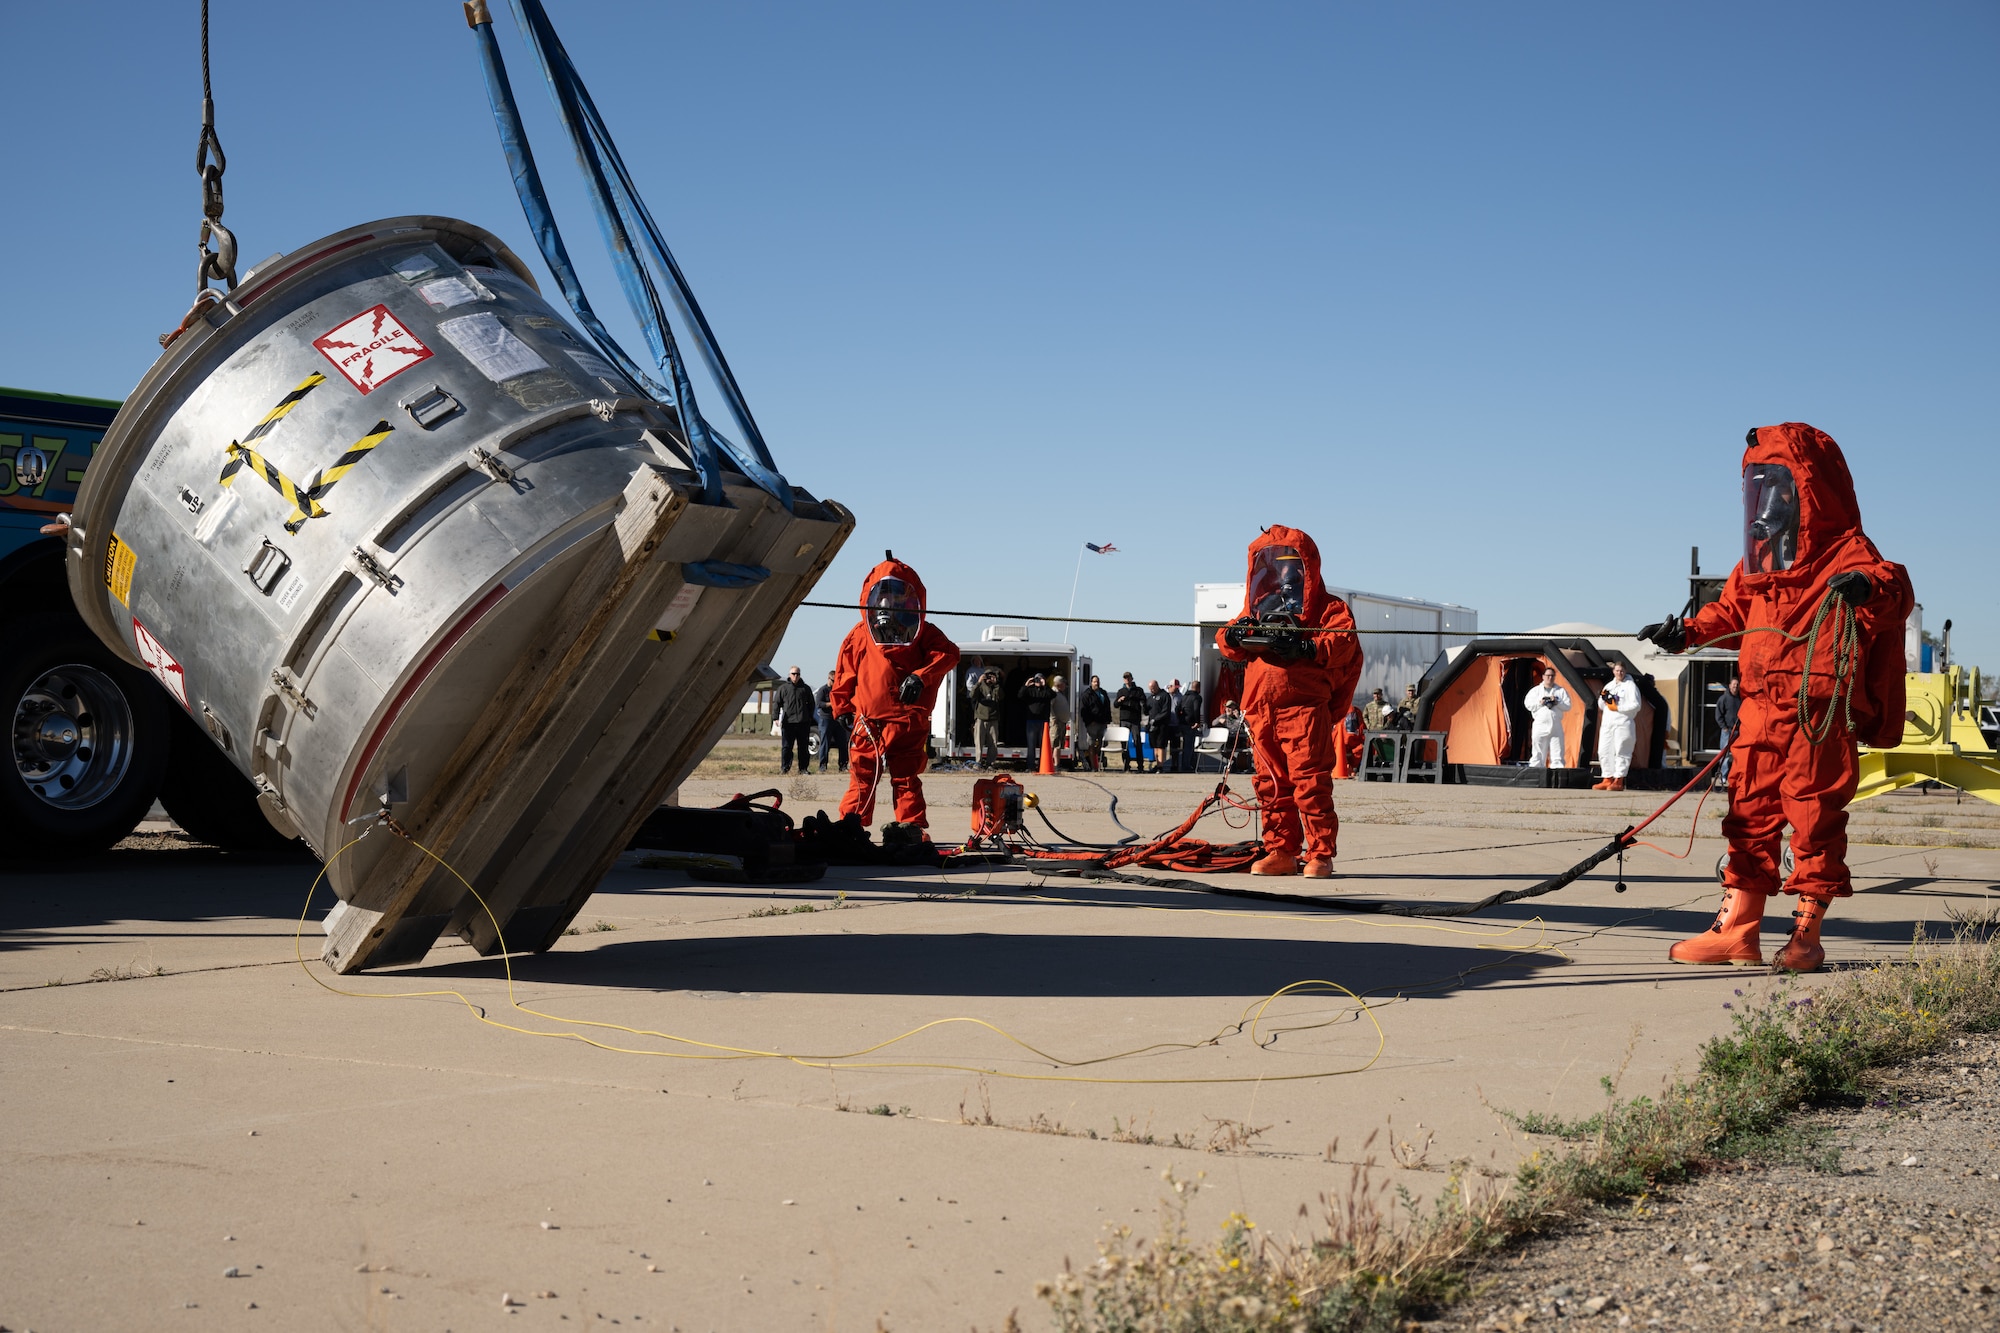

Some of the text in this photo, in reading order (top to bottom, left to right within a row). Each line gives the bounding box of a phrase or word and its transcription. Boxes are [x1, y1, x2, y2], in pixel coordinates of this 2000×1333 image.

[341, 329, 404, 368] FRAGILE
[0, 433, 100, 497] 57-
[188, 496, 200, 513] UP
[106, 539, 117, 584] CAUTION
[280, 576, 300, 605] COVER WEIGHT
[291, 583, 303, 600] POUNDS
